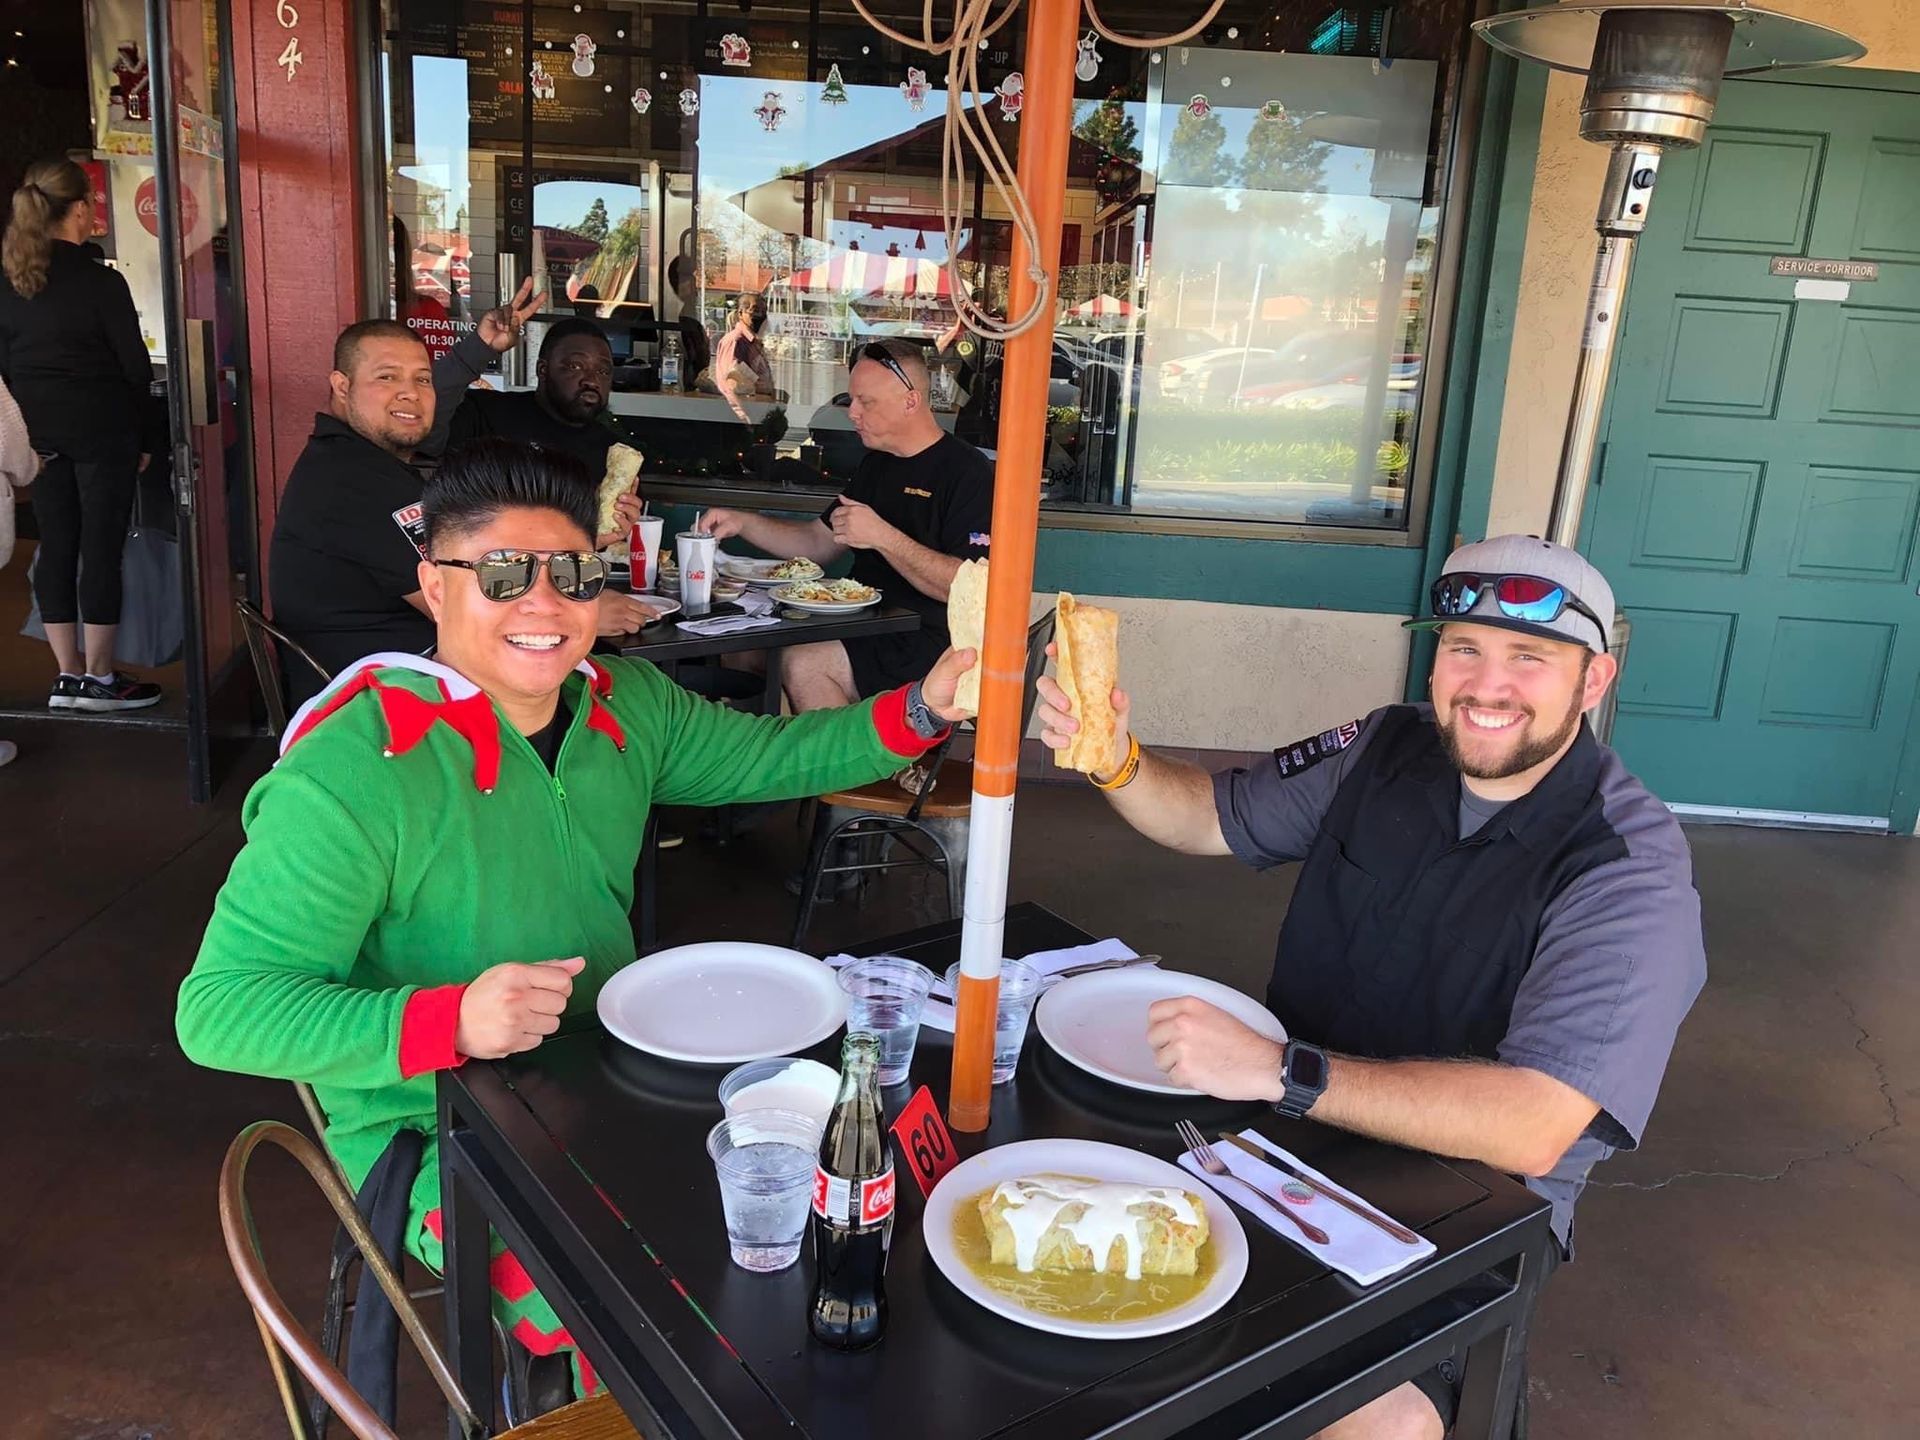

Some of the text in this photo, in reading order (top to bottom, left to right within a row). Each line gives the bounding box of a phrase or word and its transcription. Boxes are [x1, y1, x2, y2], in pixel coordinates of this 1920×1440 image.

[1777, 260, 1874, 277] SERVICE CORRIDOR
[406, 317, 477, 332] OPERATING
[911, 1112, 947, 1180] 60
